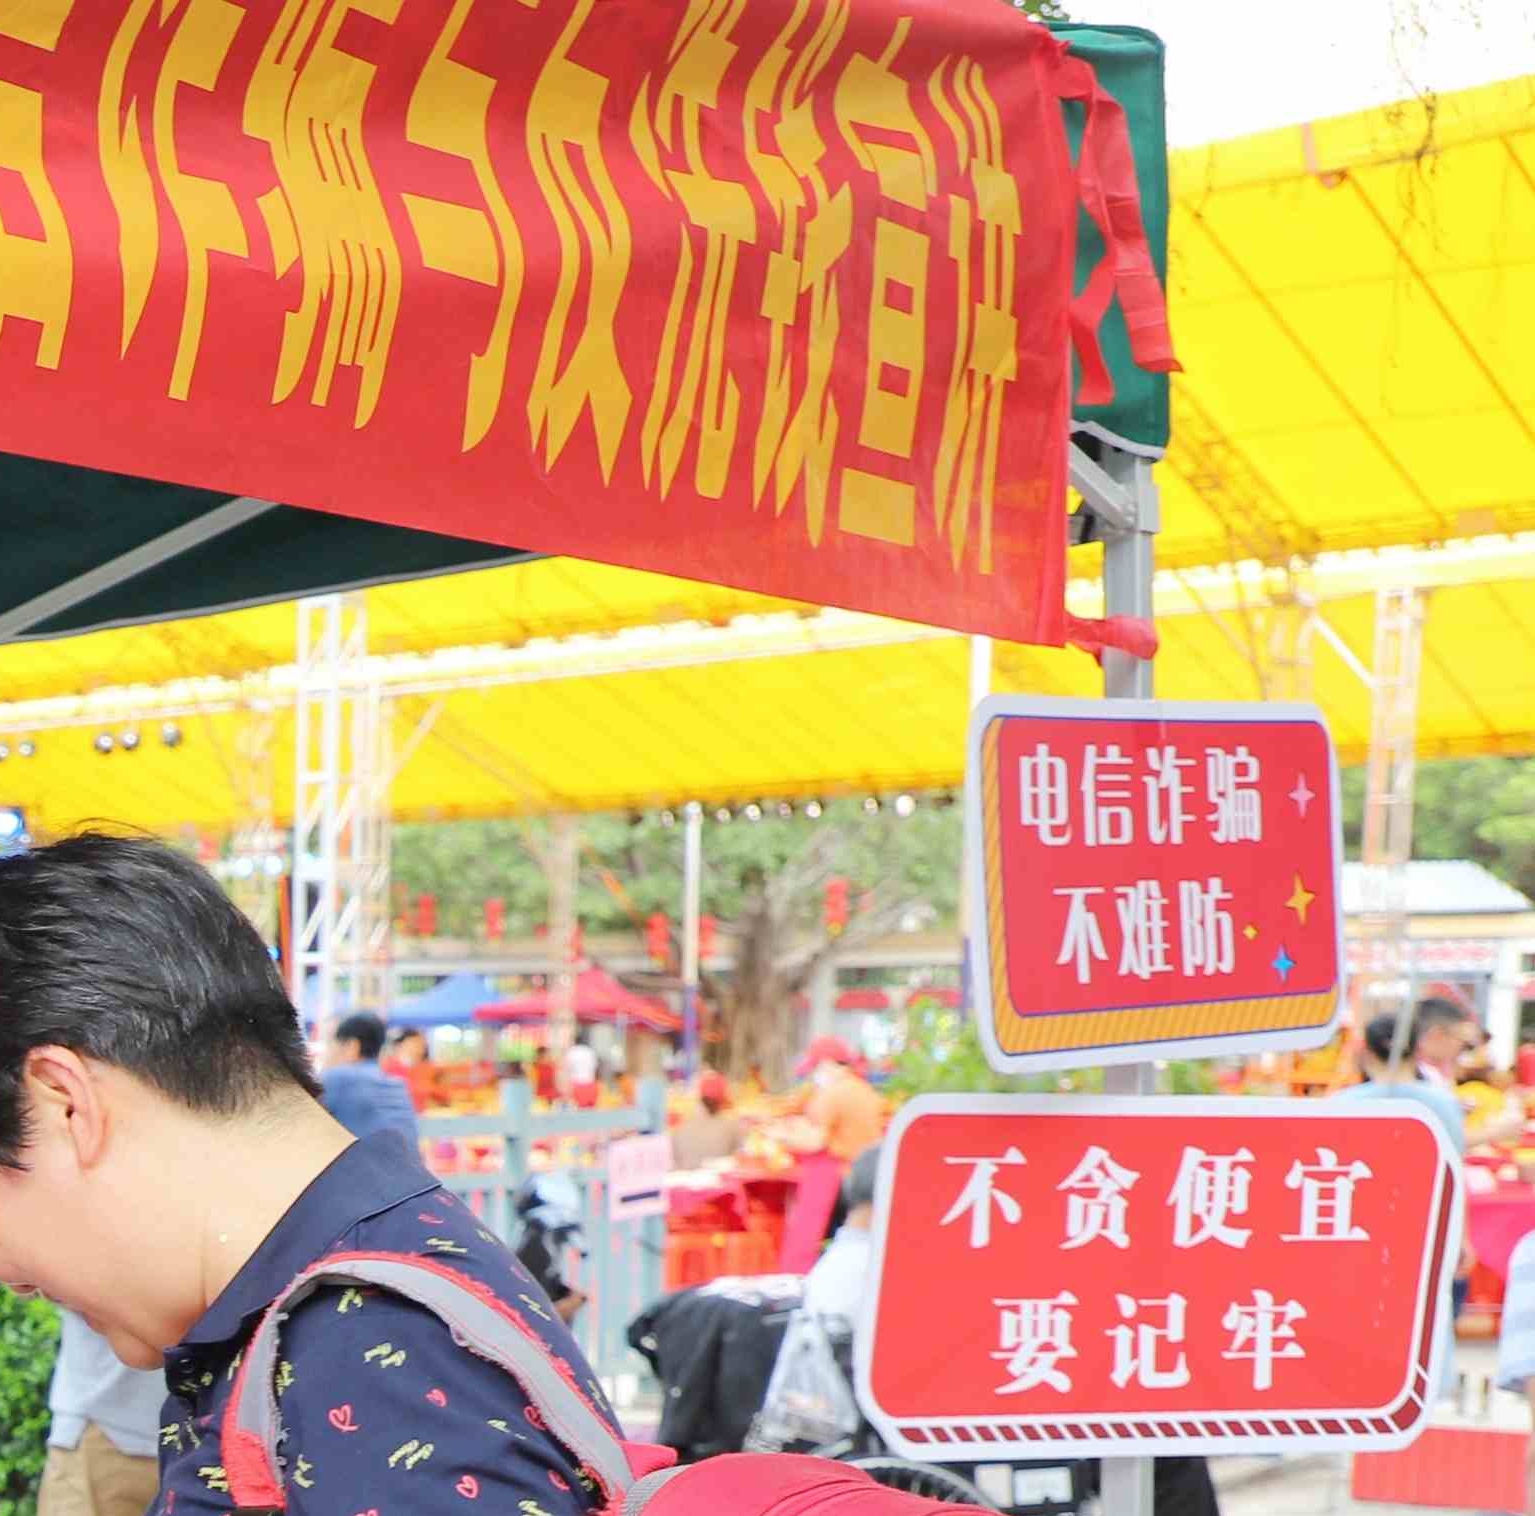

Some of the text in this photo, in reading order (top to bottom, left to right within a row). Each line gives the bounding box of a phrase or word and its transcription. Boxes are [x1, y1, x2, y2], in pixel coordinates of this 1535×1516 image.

[1018, 743, 1262, 848] 电信诈骗
[1053, 877, 1235, 984] 不难防
[939, 1146, 1373, 1250] 不贪便宜
[990, 1289, 1308, 1395] 要记牢
